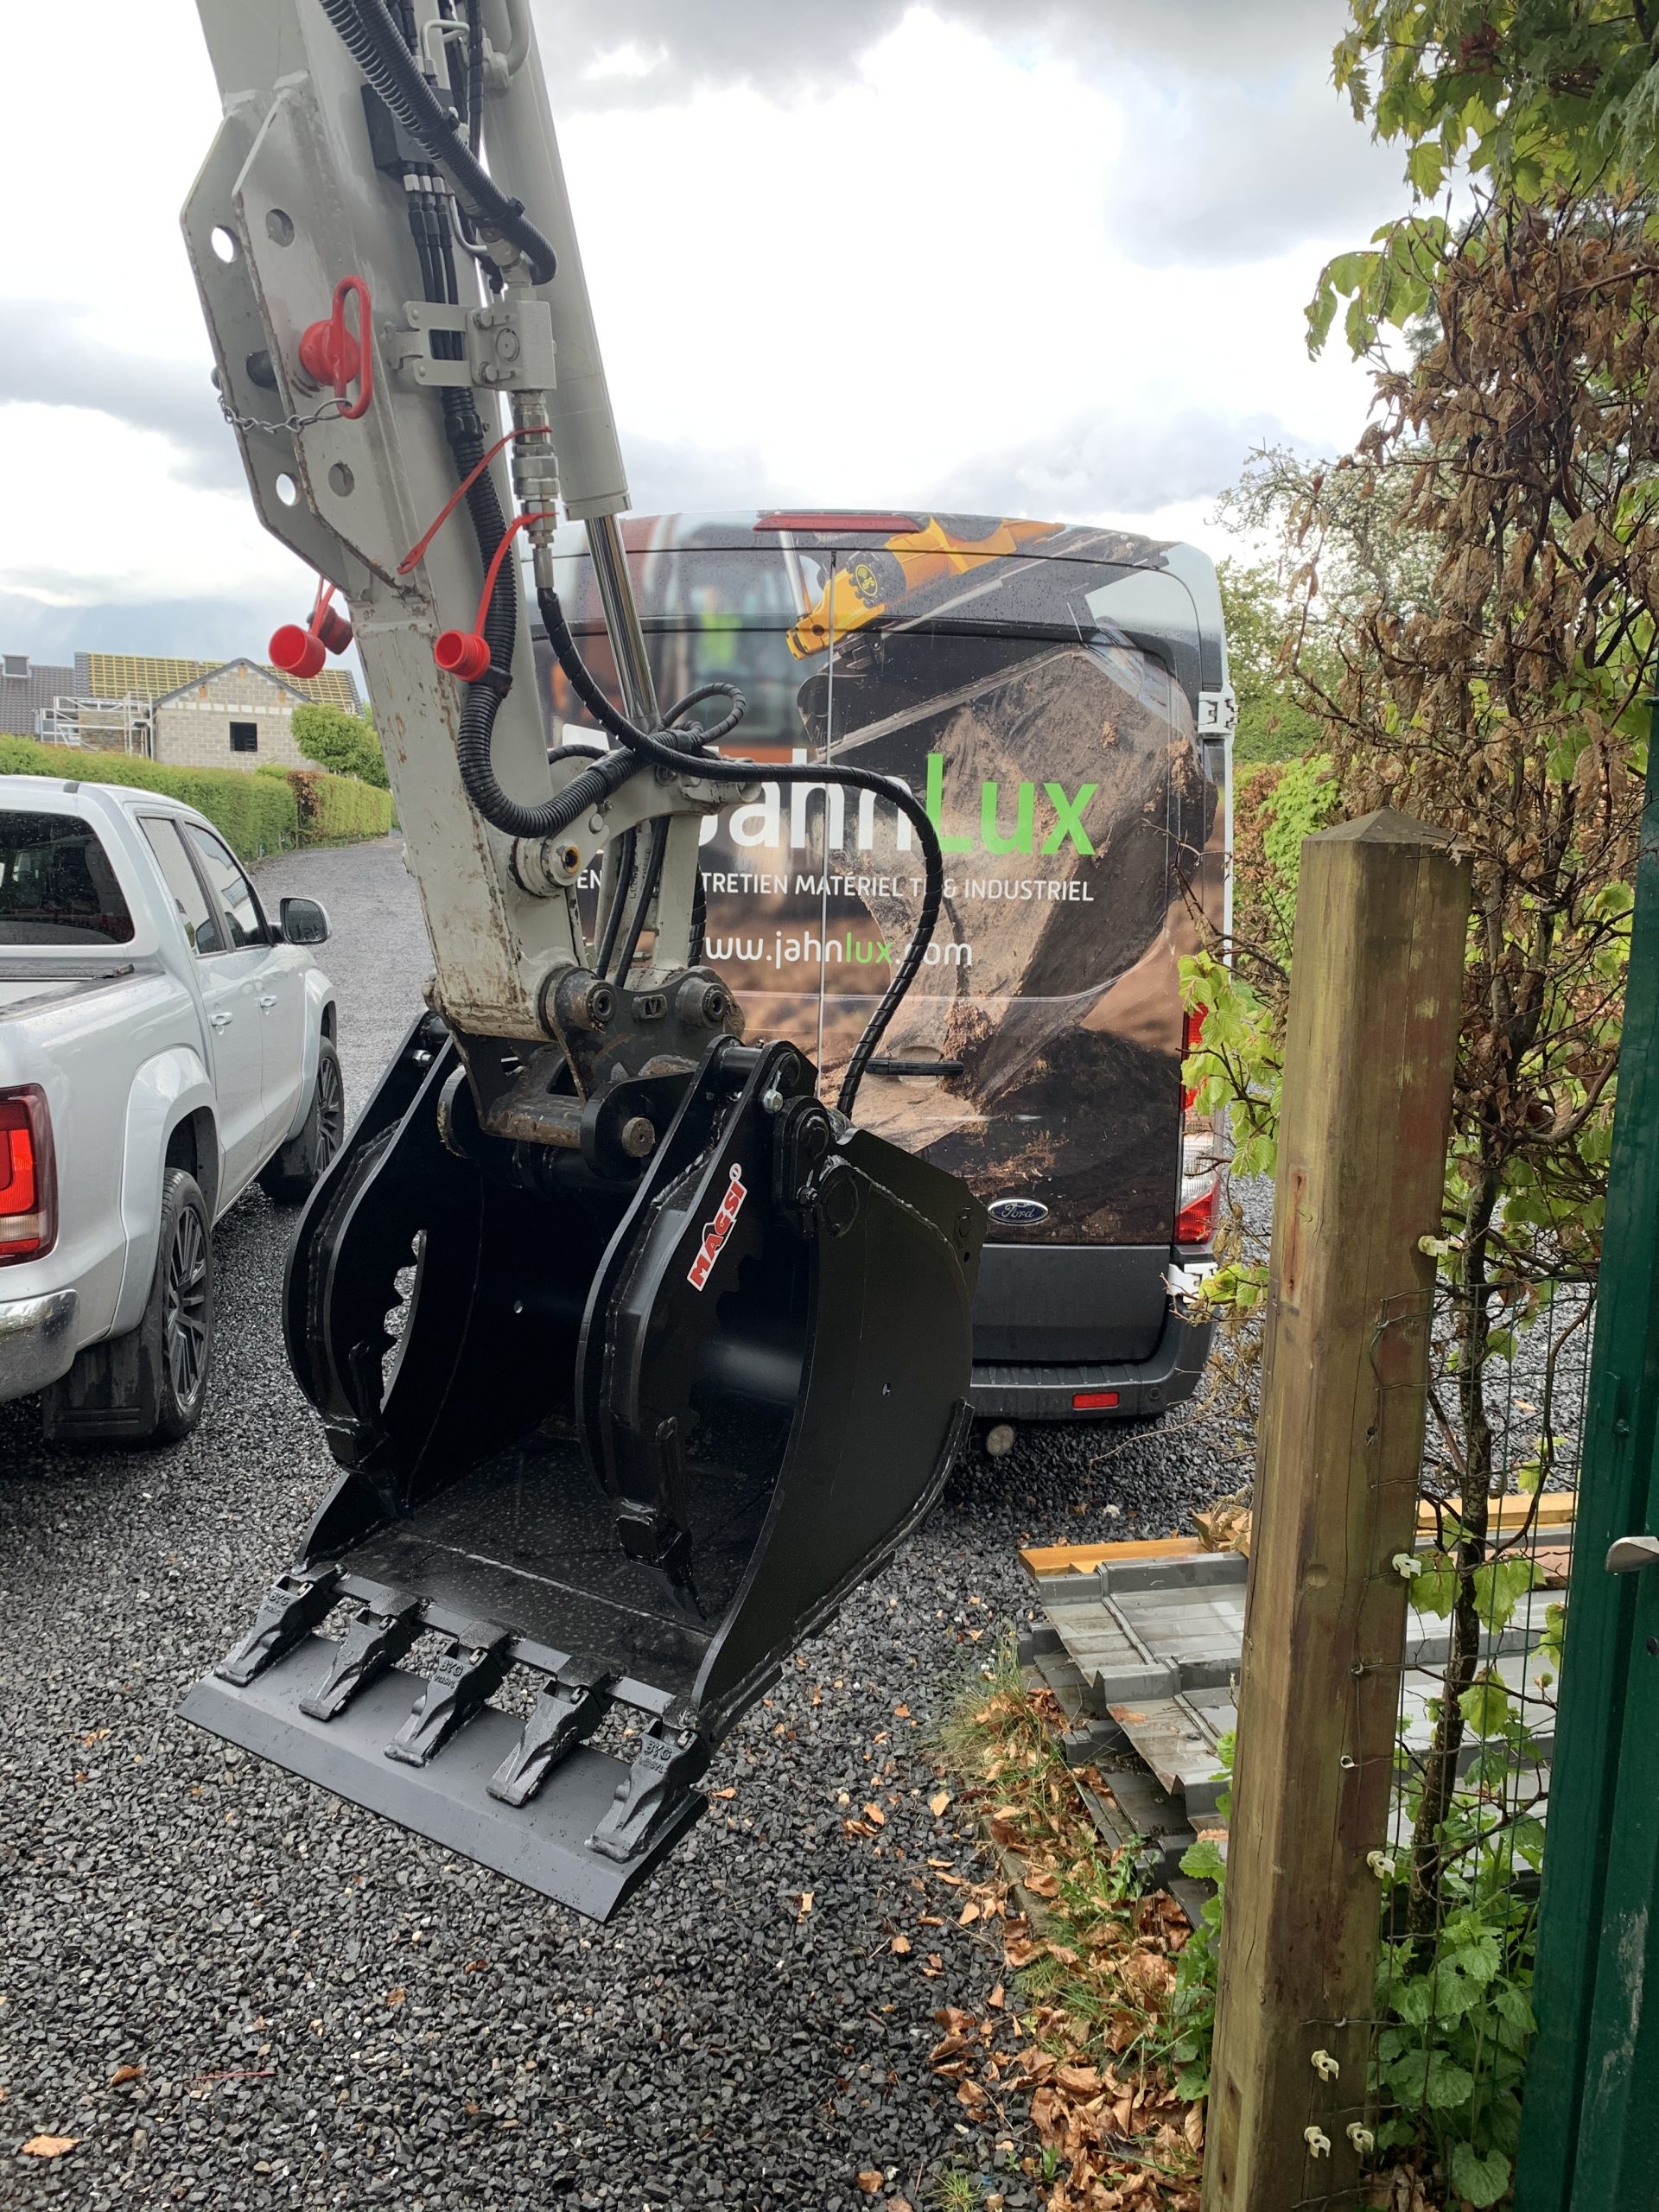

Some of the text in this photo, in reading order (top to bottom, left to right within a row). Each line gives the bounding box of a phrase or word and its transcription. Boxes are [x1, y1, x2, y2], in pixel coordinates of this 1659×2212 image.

[702, 872, 788, 894] TRETIEN
[795, 871, 904, 897] MATÉRIEL
[909, 878, 926, 898] T
[943, 878, 957, 899] &
[964, 880, 1095, 902] INDUSTRIEL
[690, 1180, 745, 1287] MAGSI
[644, 1740, 673, 1761] BYG
